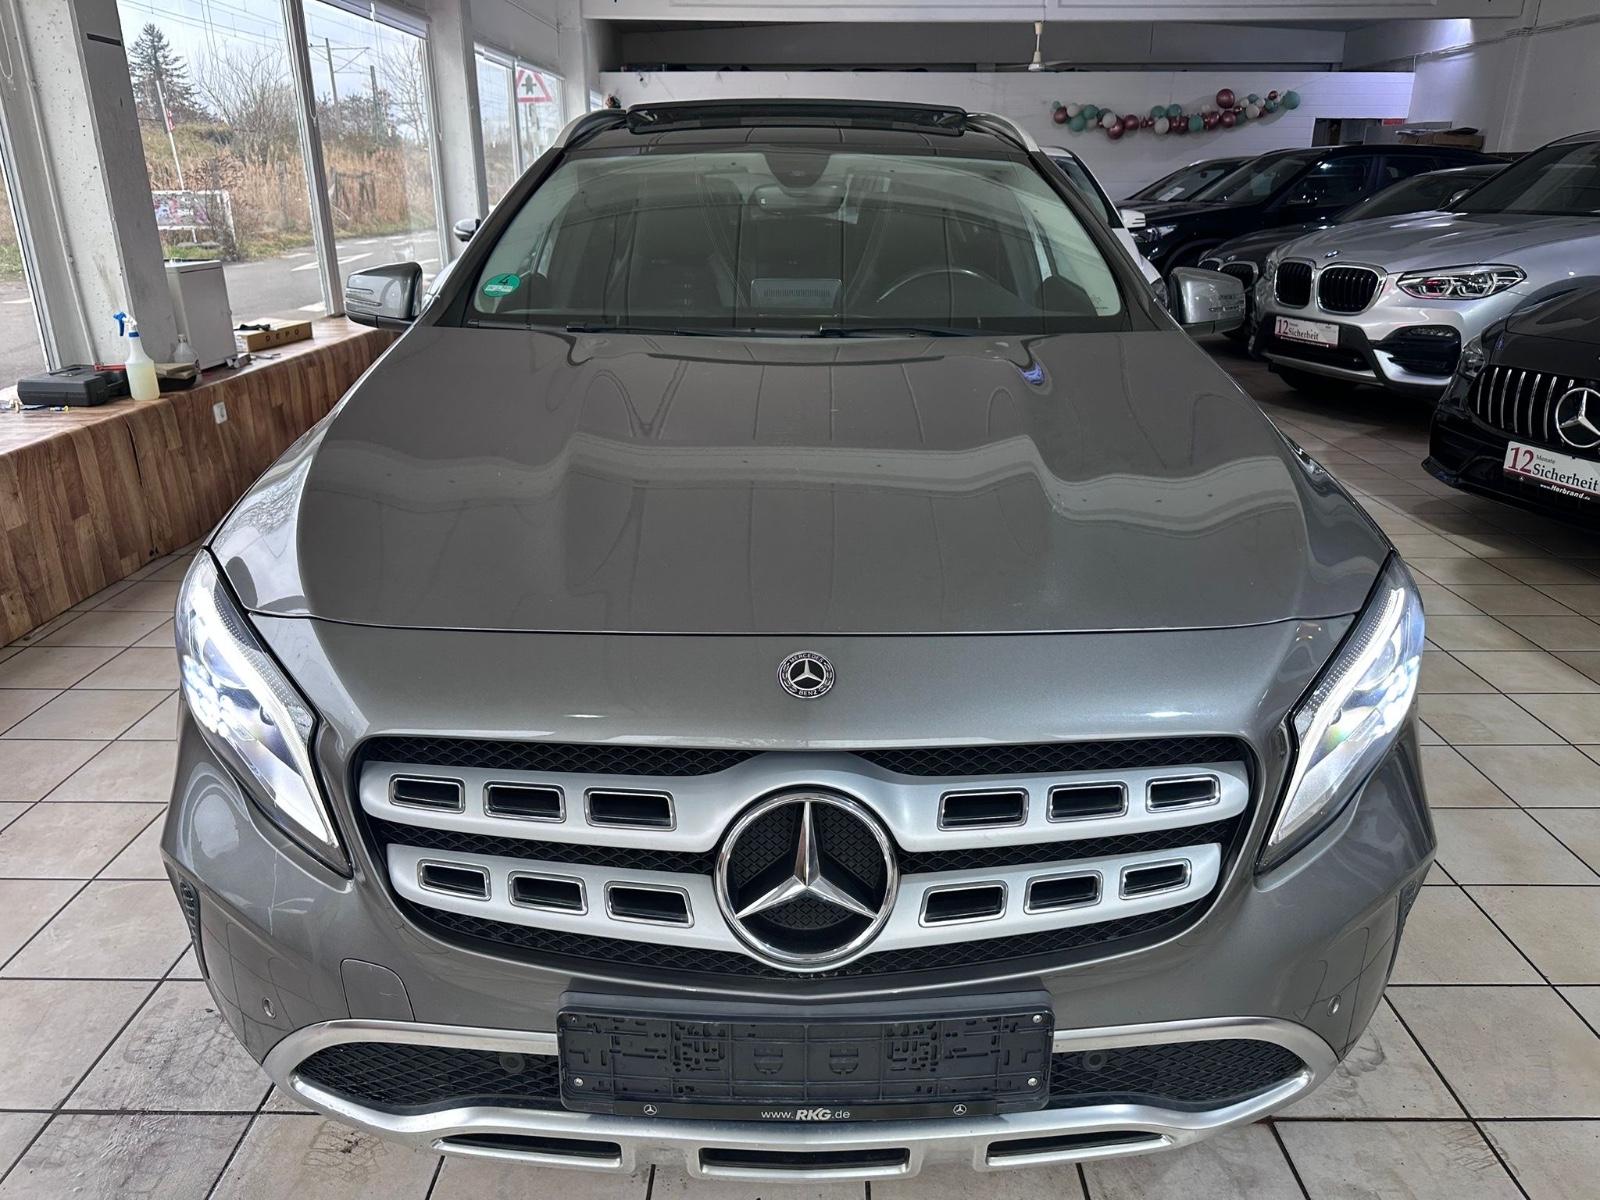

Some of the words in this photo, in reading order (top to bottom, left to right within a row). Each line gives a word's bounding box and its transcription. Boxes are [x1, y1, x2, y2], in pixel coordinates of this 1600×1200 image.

[498, 275, 510, 285] 4
[265, 328, 299, 342] DEPO
[1278, 319, 1289, 335] 12
[1288, 327, 1319, 341] Sicherheit
[1508, 446, 1535, 475] 12
[1532, 463, 1599, 492] Sicherheit
[761, 1107, 851, 1121] www.RKG.de
